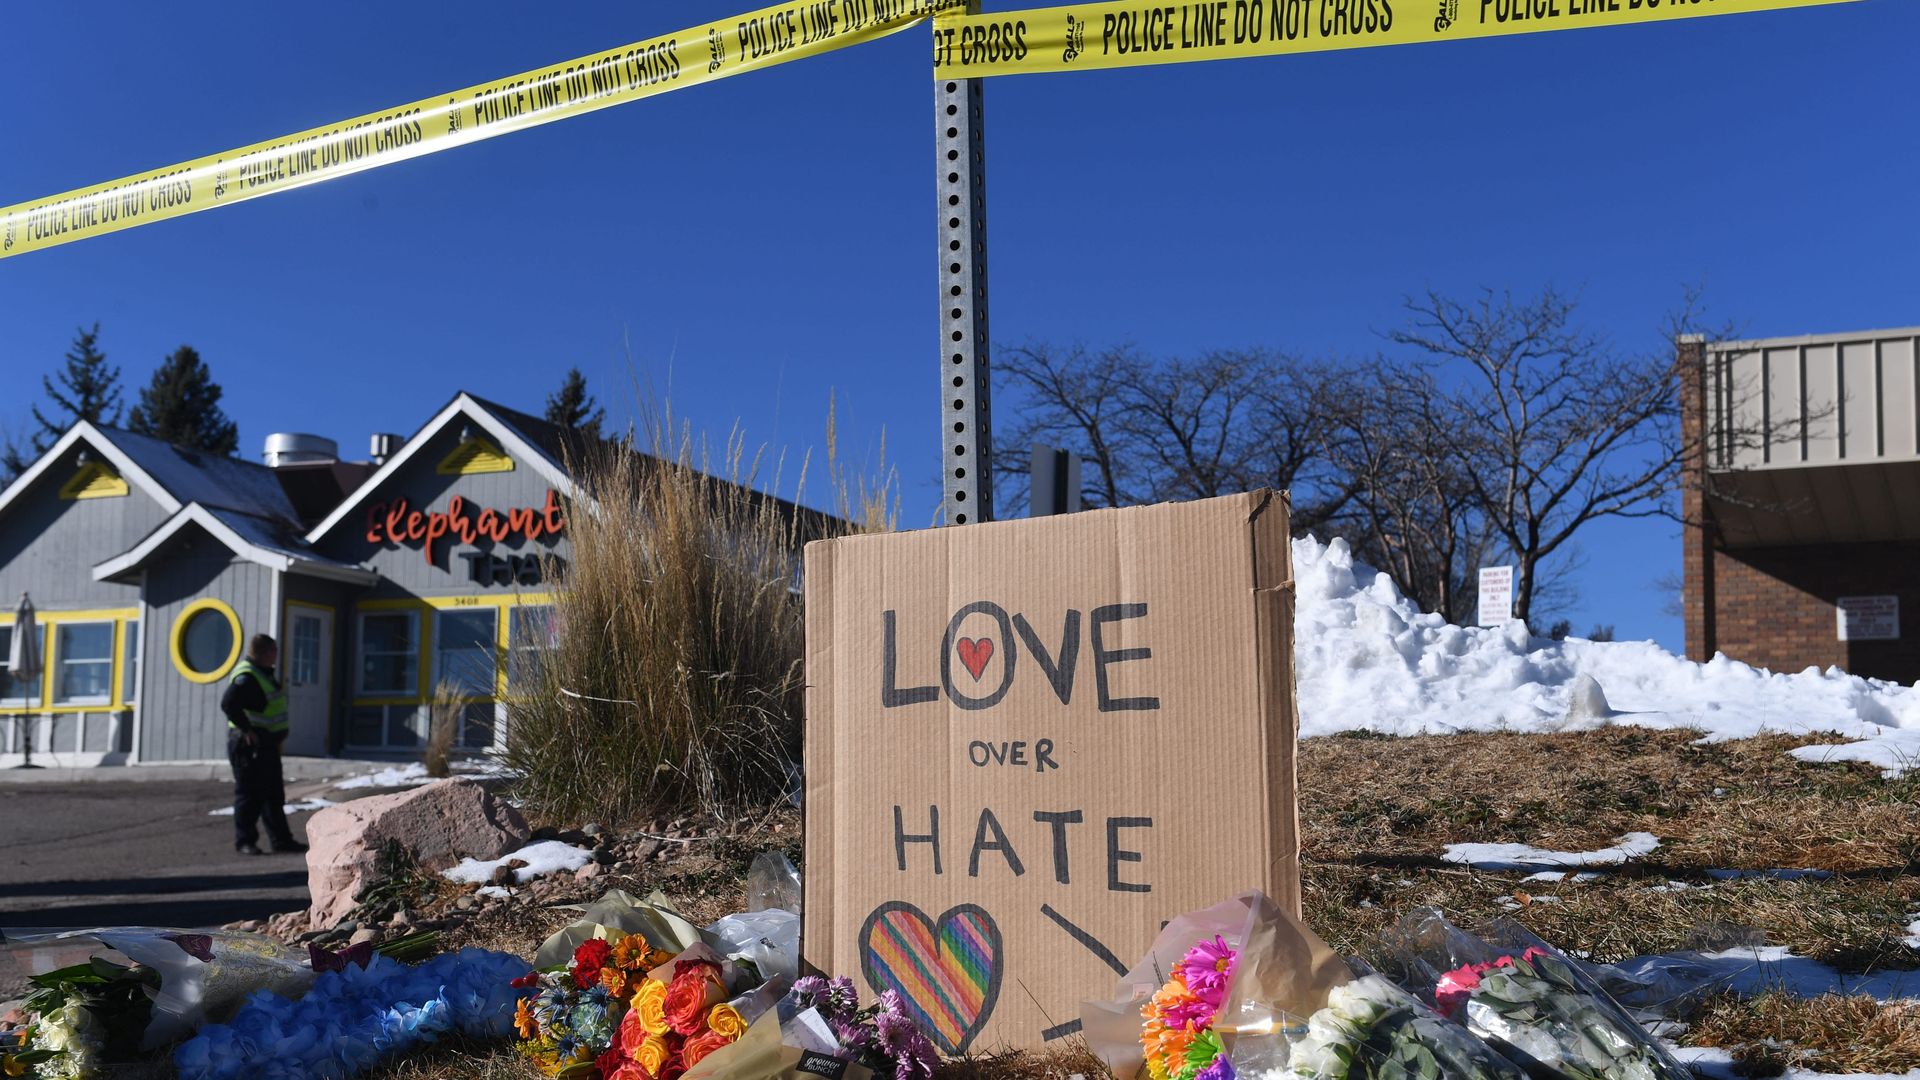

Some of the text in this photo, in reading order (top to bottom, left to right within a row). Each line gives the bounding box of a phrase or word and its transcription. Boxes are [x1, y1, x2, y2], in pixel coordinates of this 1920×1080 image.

[738, 10, 797, 61] POLICE
[801, 1, 838, 45] LINE
[842, 0, 868, 33] DO
[934, 20, 1027, 68] OT CROSS
[1103, 7, 1175, 55] POLICE
[1181, 2, 1228, 48] LINE
[1234, 0, 1263, 44] DO
[1270, 0, 1311, 41] NOT
[1320, 0, 1393, 37] CROSS
[474, 81, 526, 128] POLICE
[529, 70, 563, 113] LINE
[566, 63, 588, 105] DO
[590, 54, 622, 100] NOT
[626, 39, 680, 90] CROSS
[240, 145, 285, 190] POLICE
[288, 136, 318, 176] LINE
[322, 129, 340, 169] DO
[344, 121, 372, 163] NOT
[375, 107, 422, 154] CROSS
[27, 199, 68, 242] POLICE
[71, 192, 100, 230] LINE
[102, 186, 119, 224] DO
[122, 180, 148, 218] NOT
[150, 167, 192, 212] CROSS
[366, 489, 567, 566] Elephant
[458, 552, 562, 585] THA
[883, 600, 1160, 712] LOVE
[969, 738, 1059, 772] OVER
[893, 805, 1153, 893] HATE
[804, 1057, 840, 1069] grower
[807, 1065, 834, 1075] BUNCH
